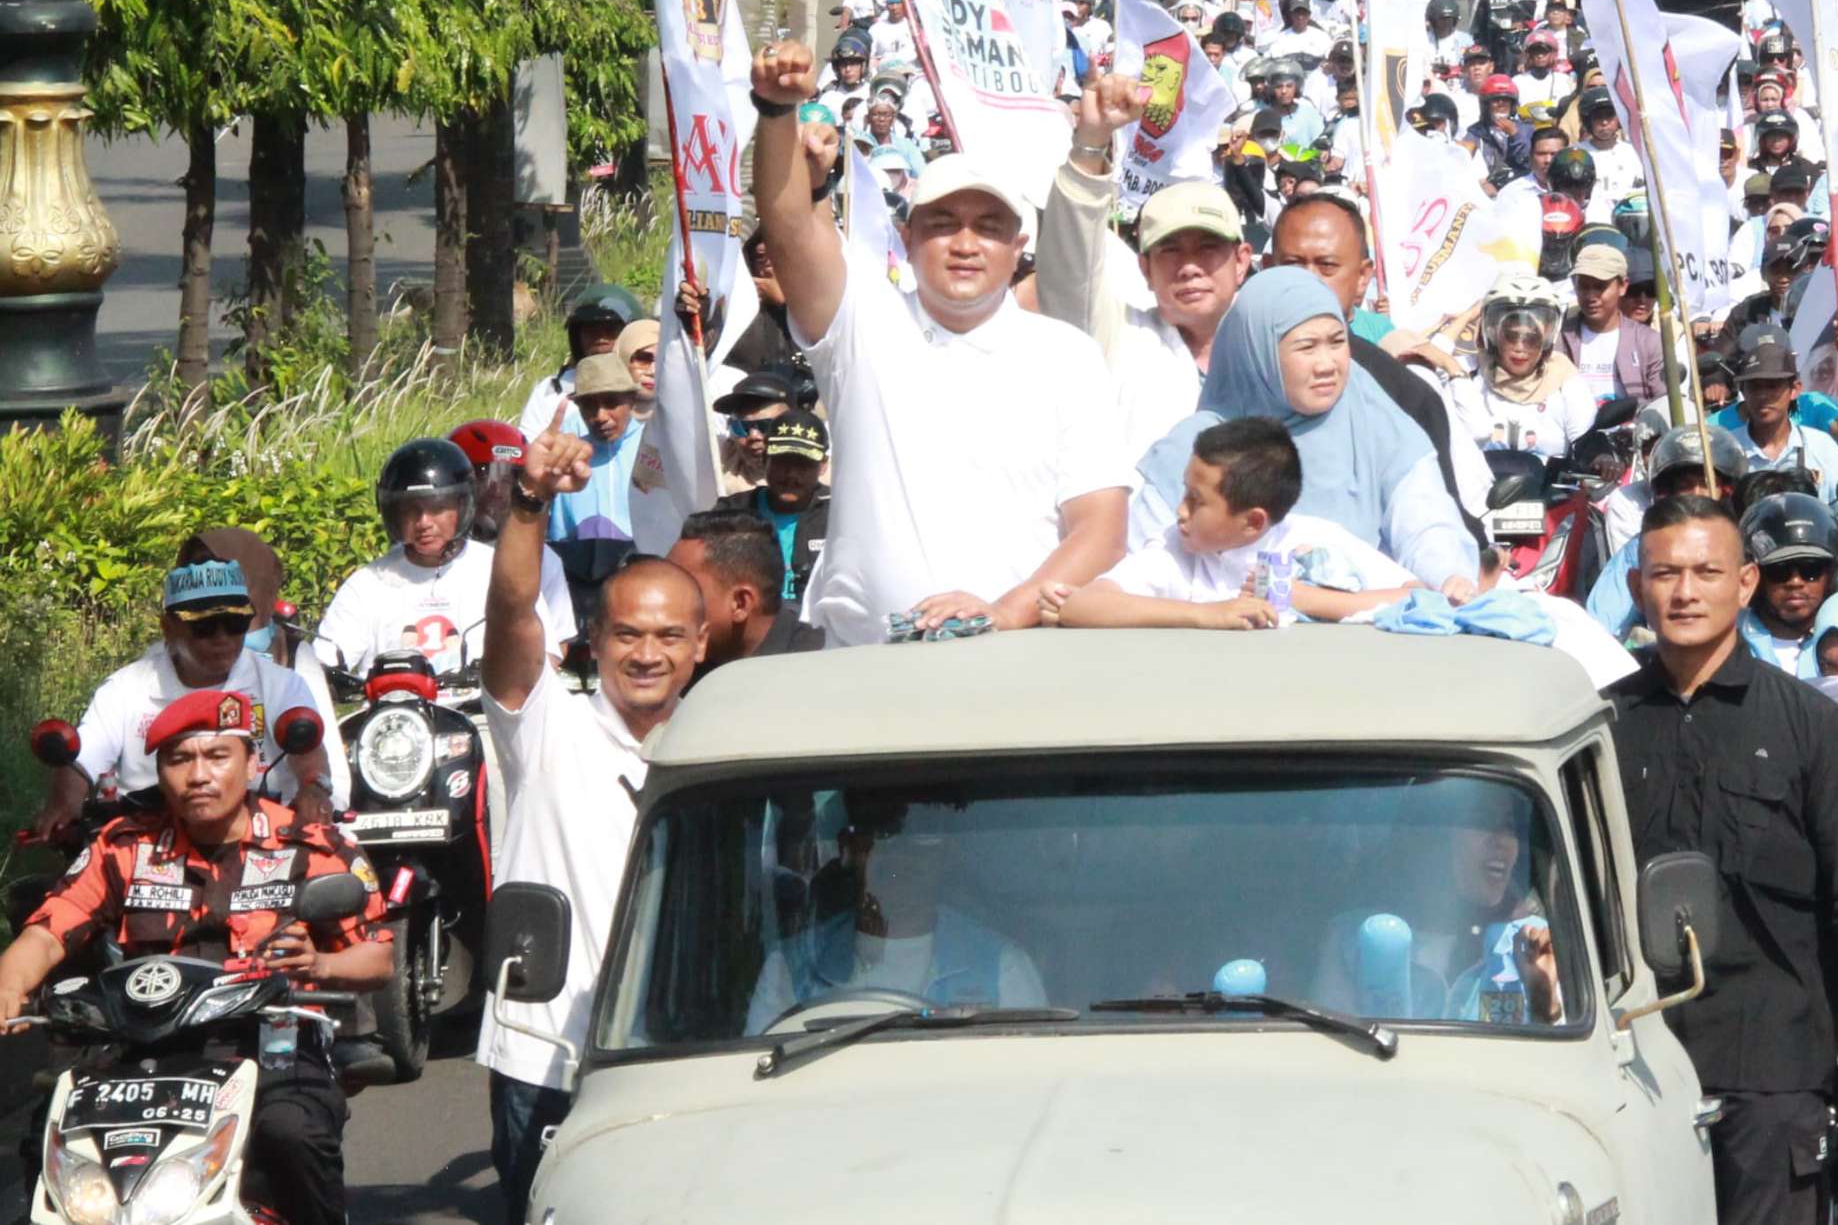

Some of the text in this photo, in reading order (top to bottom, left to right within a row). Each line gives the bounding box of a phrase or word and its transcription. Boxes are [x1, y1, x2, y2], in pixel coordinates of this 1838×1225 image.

[67, 1081, 215, 1109] F 2405 MH
